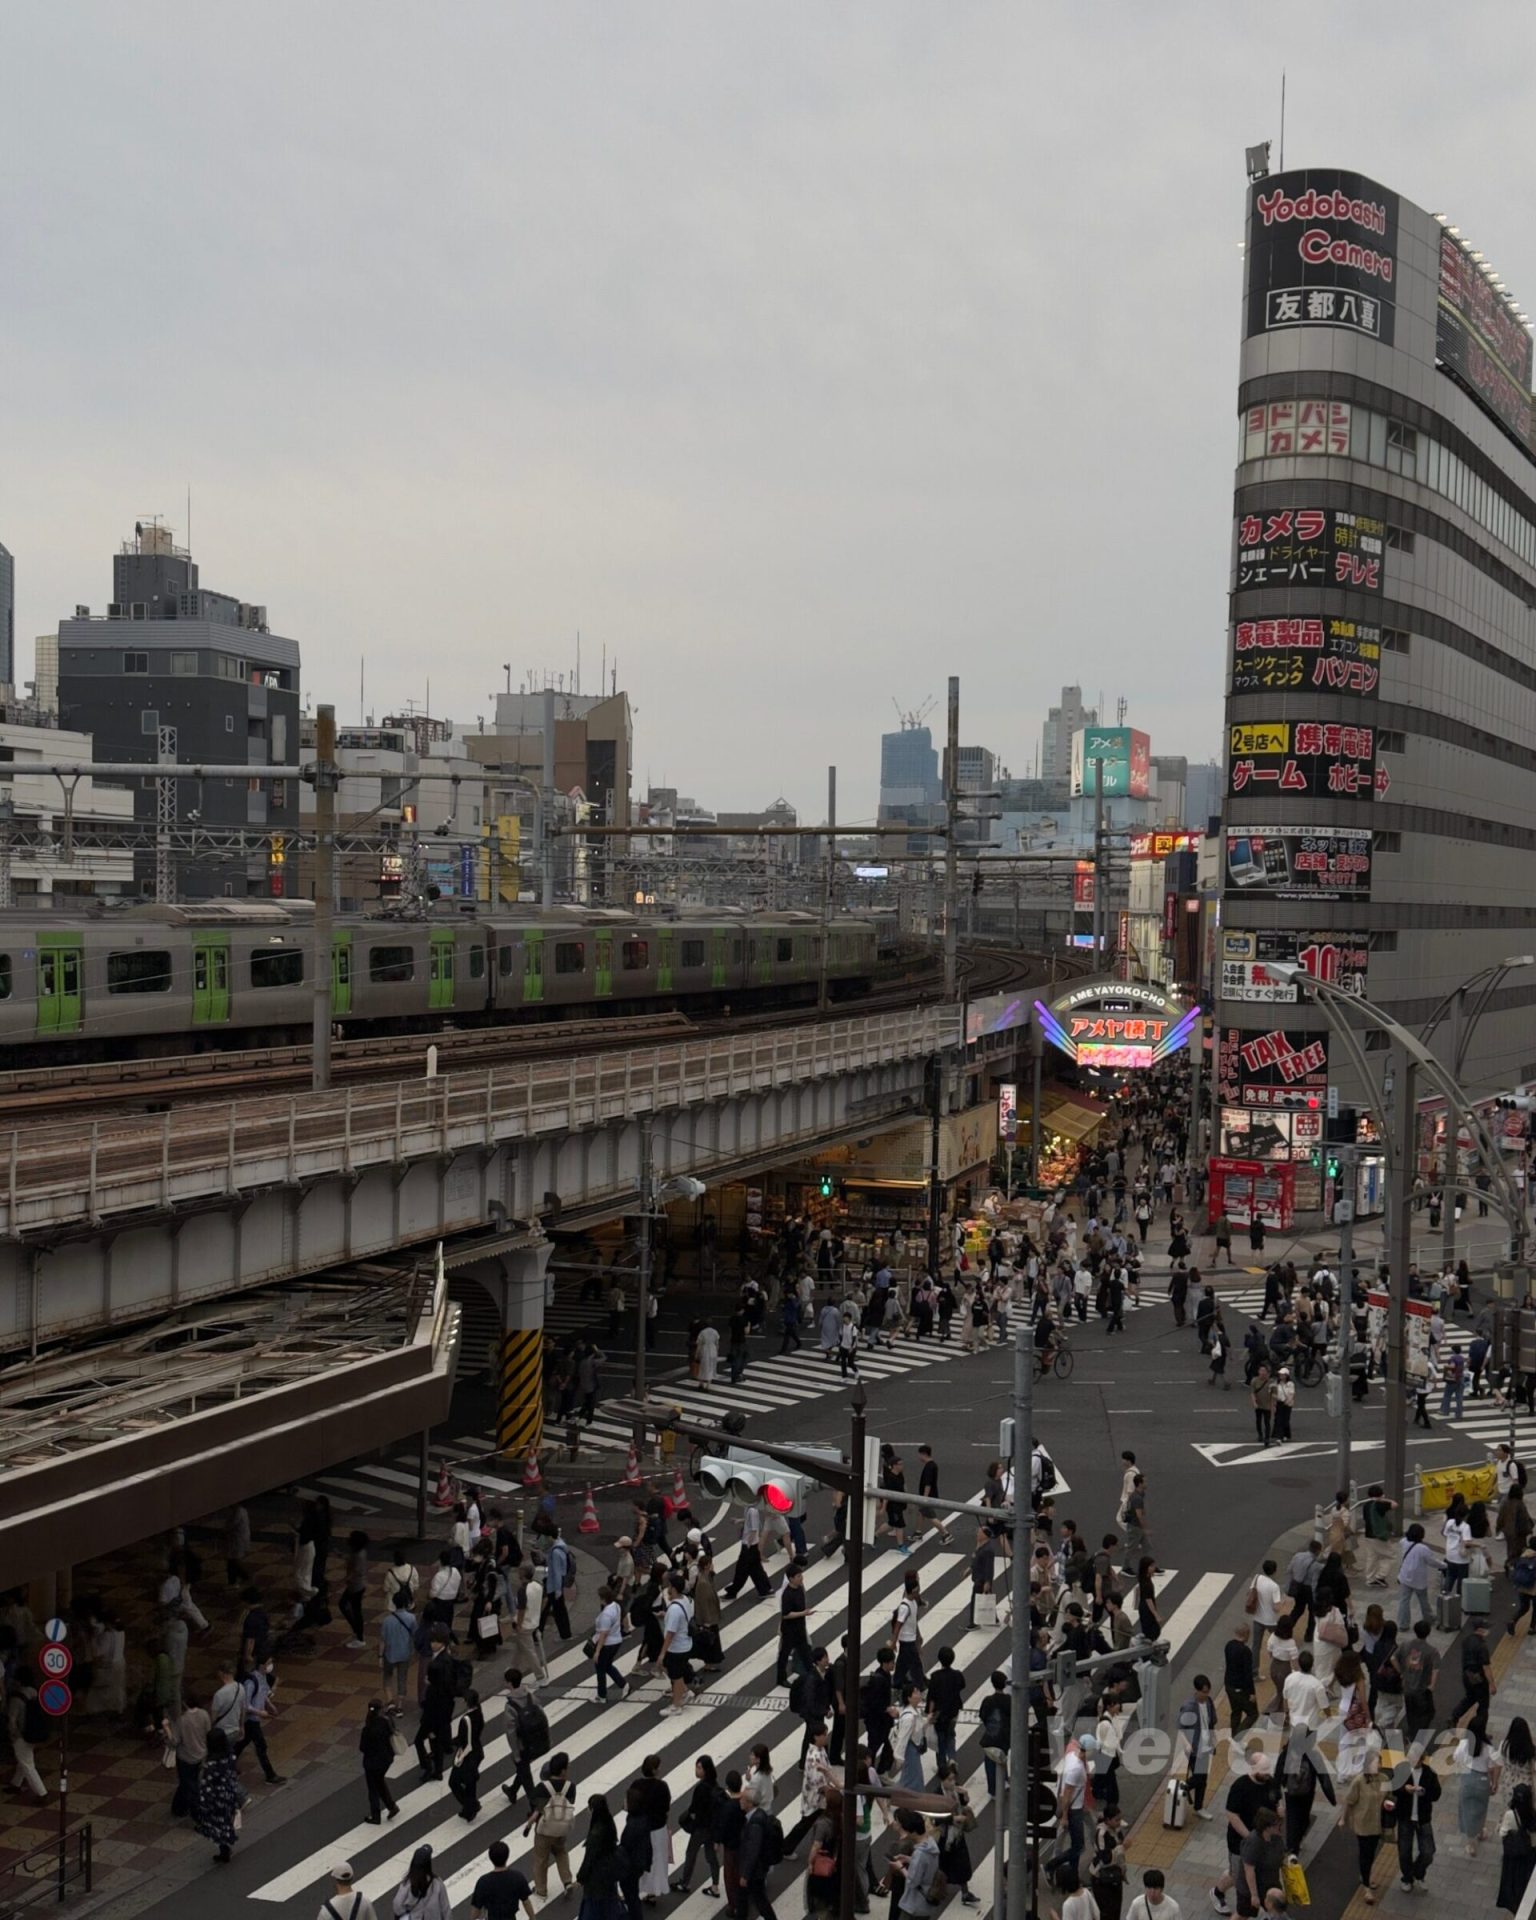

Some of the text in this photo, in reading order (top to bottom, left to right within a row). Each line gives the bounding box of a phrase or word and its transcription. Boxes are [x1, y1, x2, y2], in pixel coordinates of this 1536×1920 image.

[1257, 188, 1386, 236] Yodobashi
[1299, 229, 1393, 283] Camera
[1274, 290, 1377, 330] 友都八喜
[1248, 402, 1349, 433] ヨドバシ
[1270, 430, 1349, 453] カメラ
[1239, 510, 1325, 546] カメラ
[1334, 526, 1358, 549] 時計
[1269, 545, 1330, 561] ドライヤー
[1240, 561, 1326, 585] シェーバー
[1335, 551, 1380, 589] テレビ
[1236, 619, 1325, 651] 家電製品
[1329, 638, 1359, 654] エアコン
[1235, 655, 1304, 673] スーツケース
[1312, 656, 1378, 692] パソコン
[1234, 671, 1304, 688] マウス インク
[1232, 728, 1284, 753] 2号店へ
[1295, 723, 1373, 760] 携帯電話
[1232, 759, 1308, 791] ゲーム
[1328, 762, 1372, 793] ホビー
[1223, 963, 1246, 974] 入会金
[1223, 975, 1246, 986] 年会費
[1071, 1018, 1168, 1041] アメヤ横丁
[1240, 1030, 1296, 1072] TAX
[1277, 1040, 1327, 1084] FREE
[47, 1652, 65, 1669] 30
